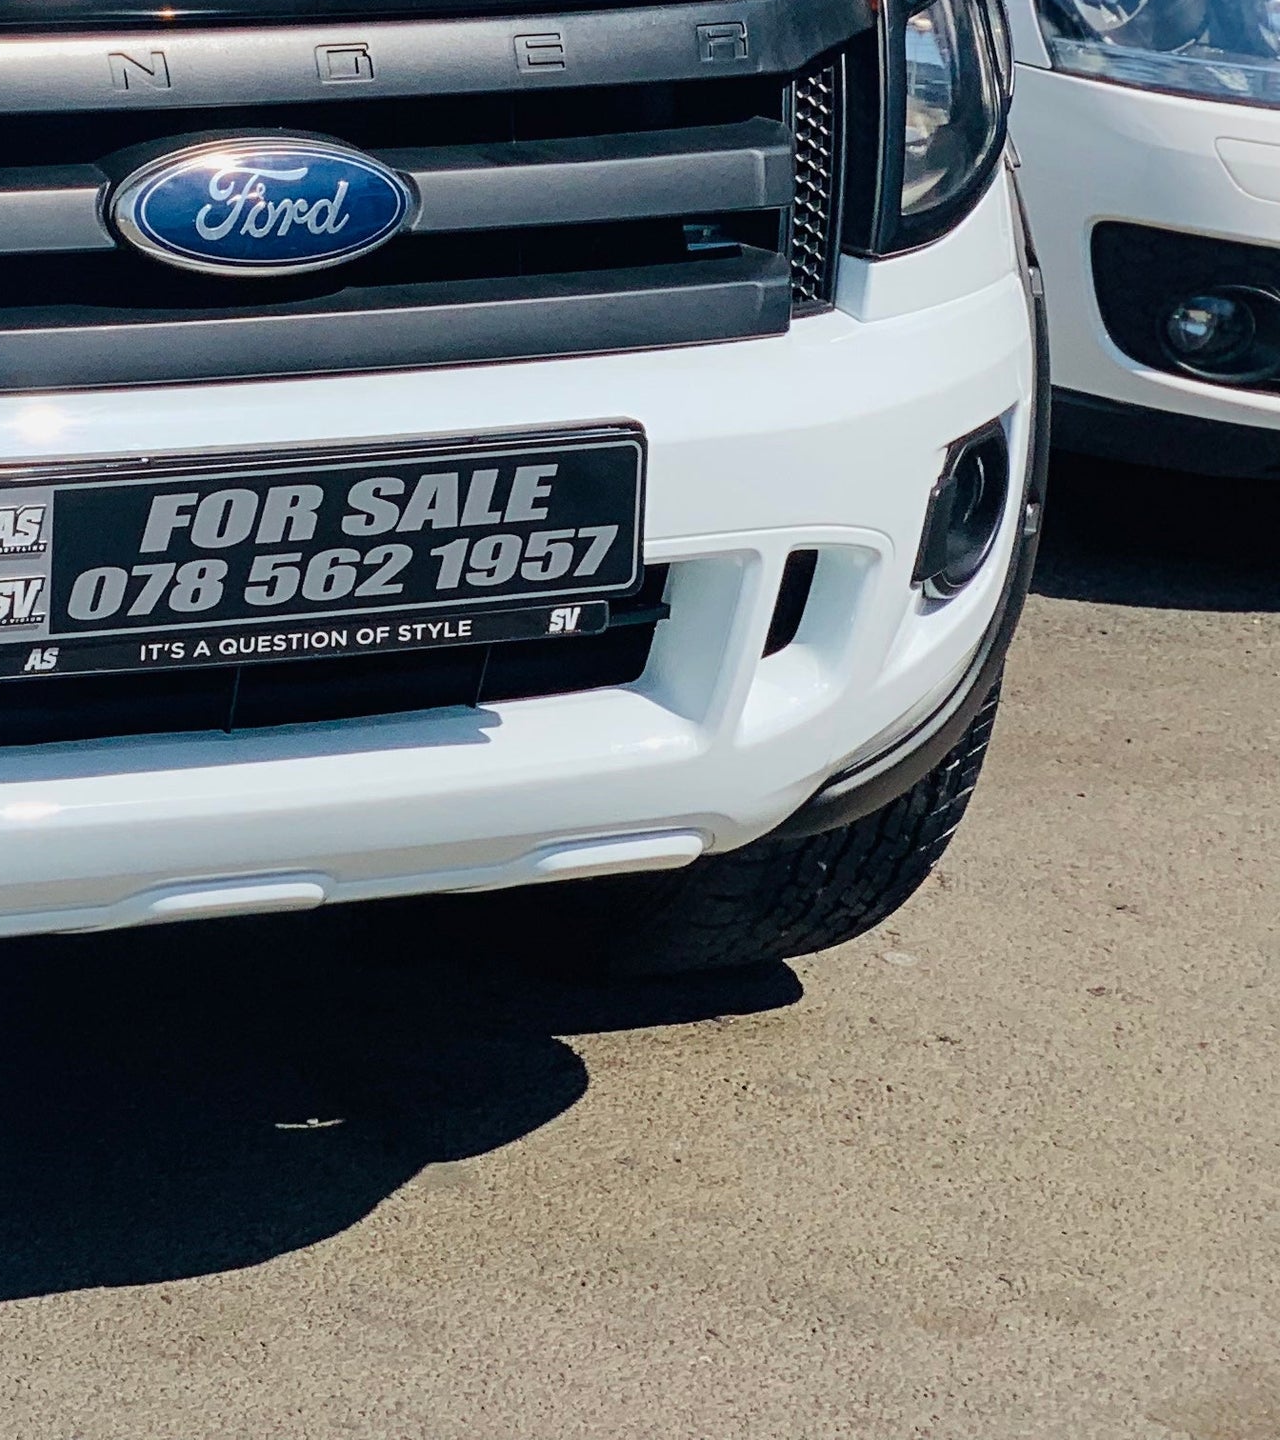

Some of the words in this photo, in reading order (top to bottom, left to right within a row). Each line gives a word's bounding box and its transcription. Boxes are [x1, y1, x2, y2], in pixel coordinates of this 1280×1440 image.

[195, 166, 351, 241] Ford
[139, 484, 324, 553] FOR
[341, 464, 559, 537] SALE
[67, 558, 229, 621] 078
[244, 543, 414, 606] 562
[430, 524, 619, 590] 1957
[140, 642, 186, 662] IT'S
[193, 640, 211, 658] A
[218, 630, 348, 656] QUESTION
[355, 626, 390, 646] OF
[397, 620, 473, 643] STYLE
[548, 606, 582, 632] SV
[24, 646, 60, 671] AS
